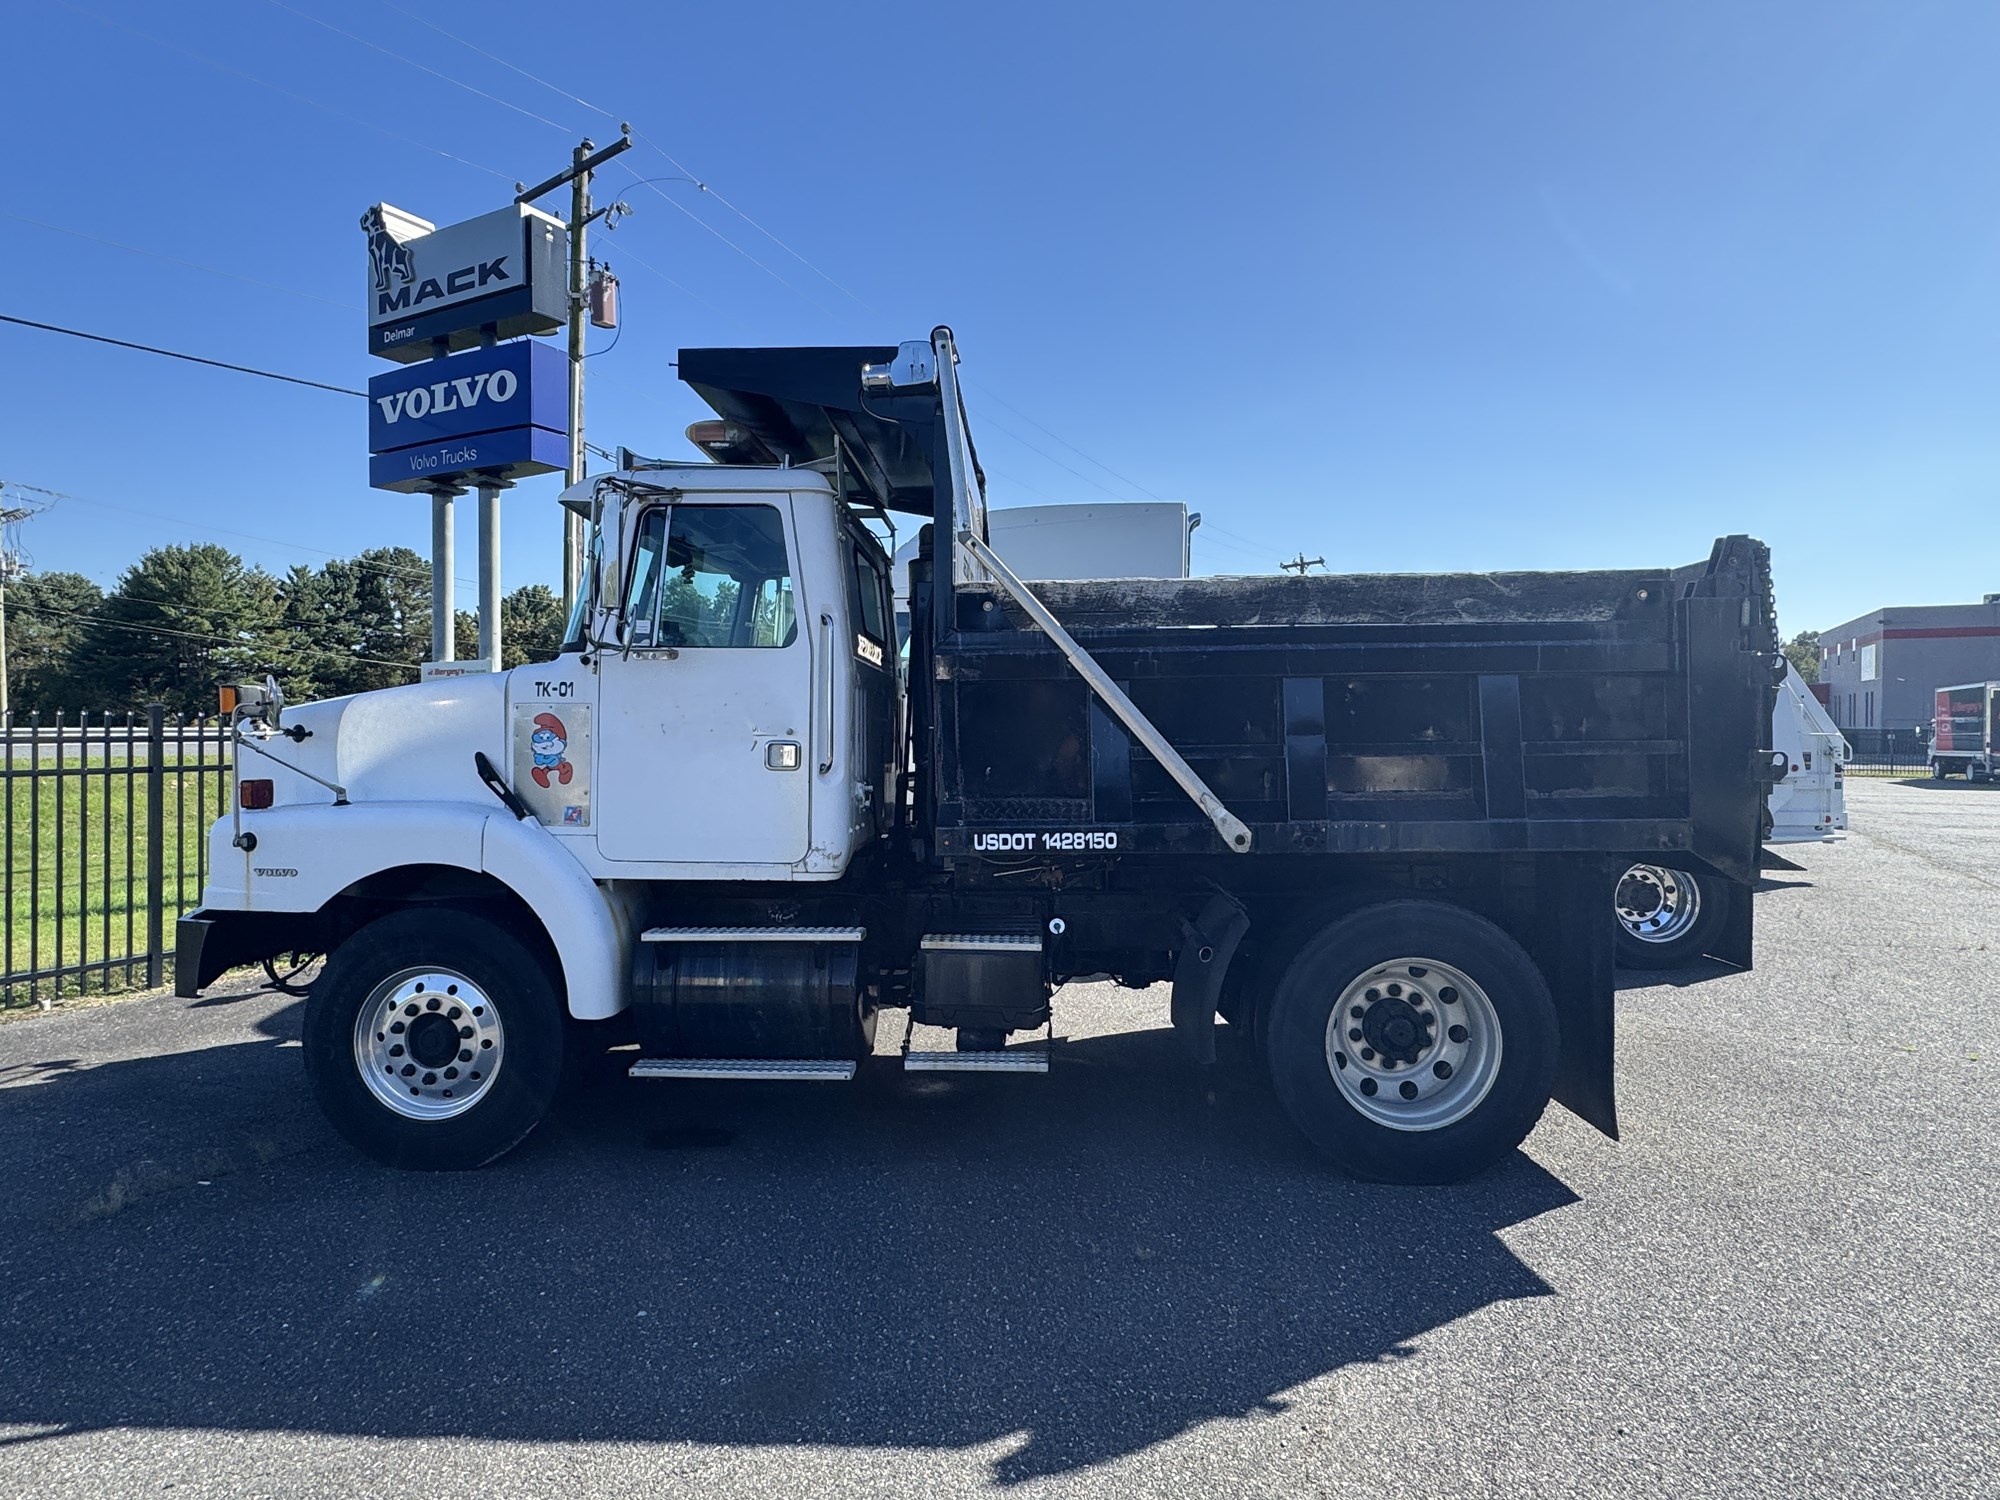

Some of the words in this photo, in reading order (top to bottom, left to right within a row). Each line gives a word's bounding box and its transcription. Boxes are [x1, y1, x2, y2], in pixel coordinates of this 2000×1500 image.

[378, 255, 510, 316] MACK
[383, 325, 416, 343] Delmar
[377, 369, 518, 424] VOLVO
[409, 452, 438, 471] Volvo
[440, 447, 478, 465] Trucks
[534, 681, 574, 698] TK-01
[973, 833, 1037, 851] USDOT
[1041, 832, 1118, 850] 1428150
[253, 867, 299, 877] VOLVO
